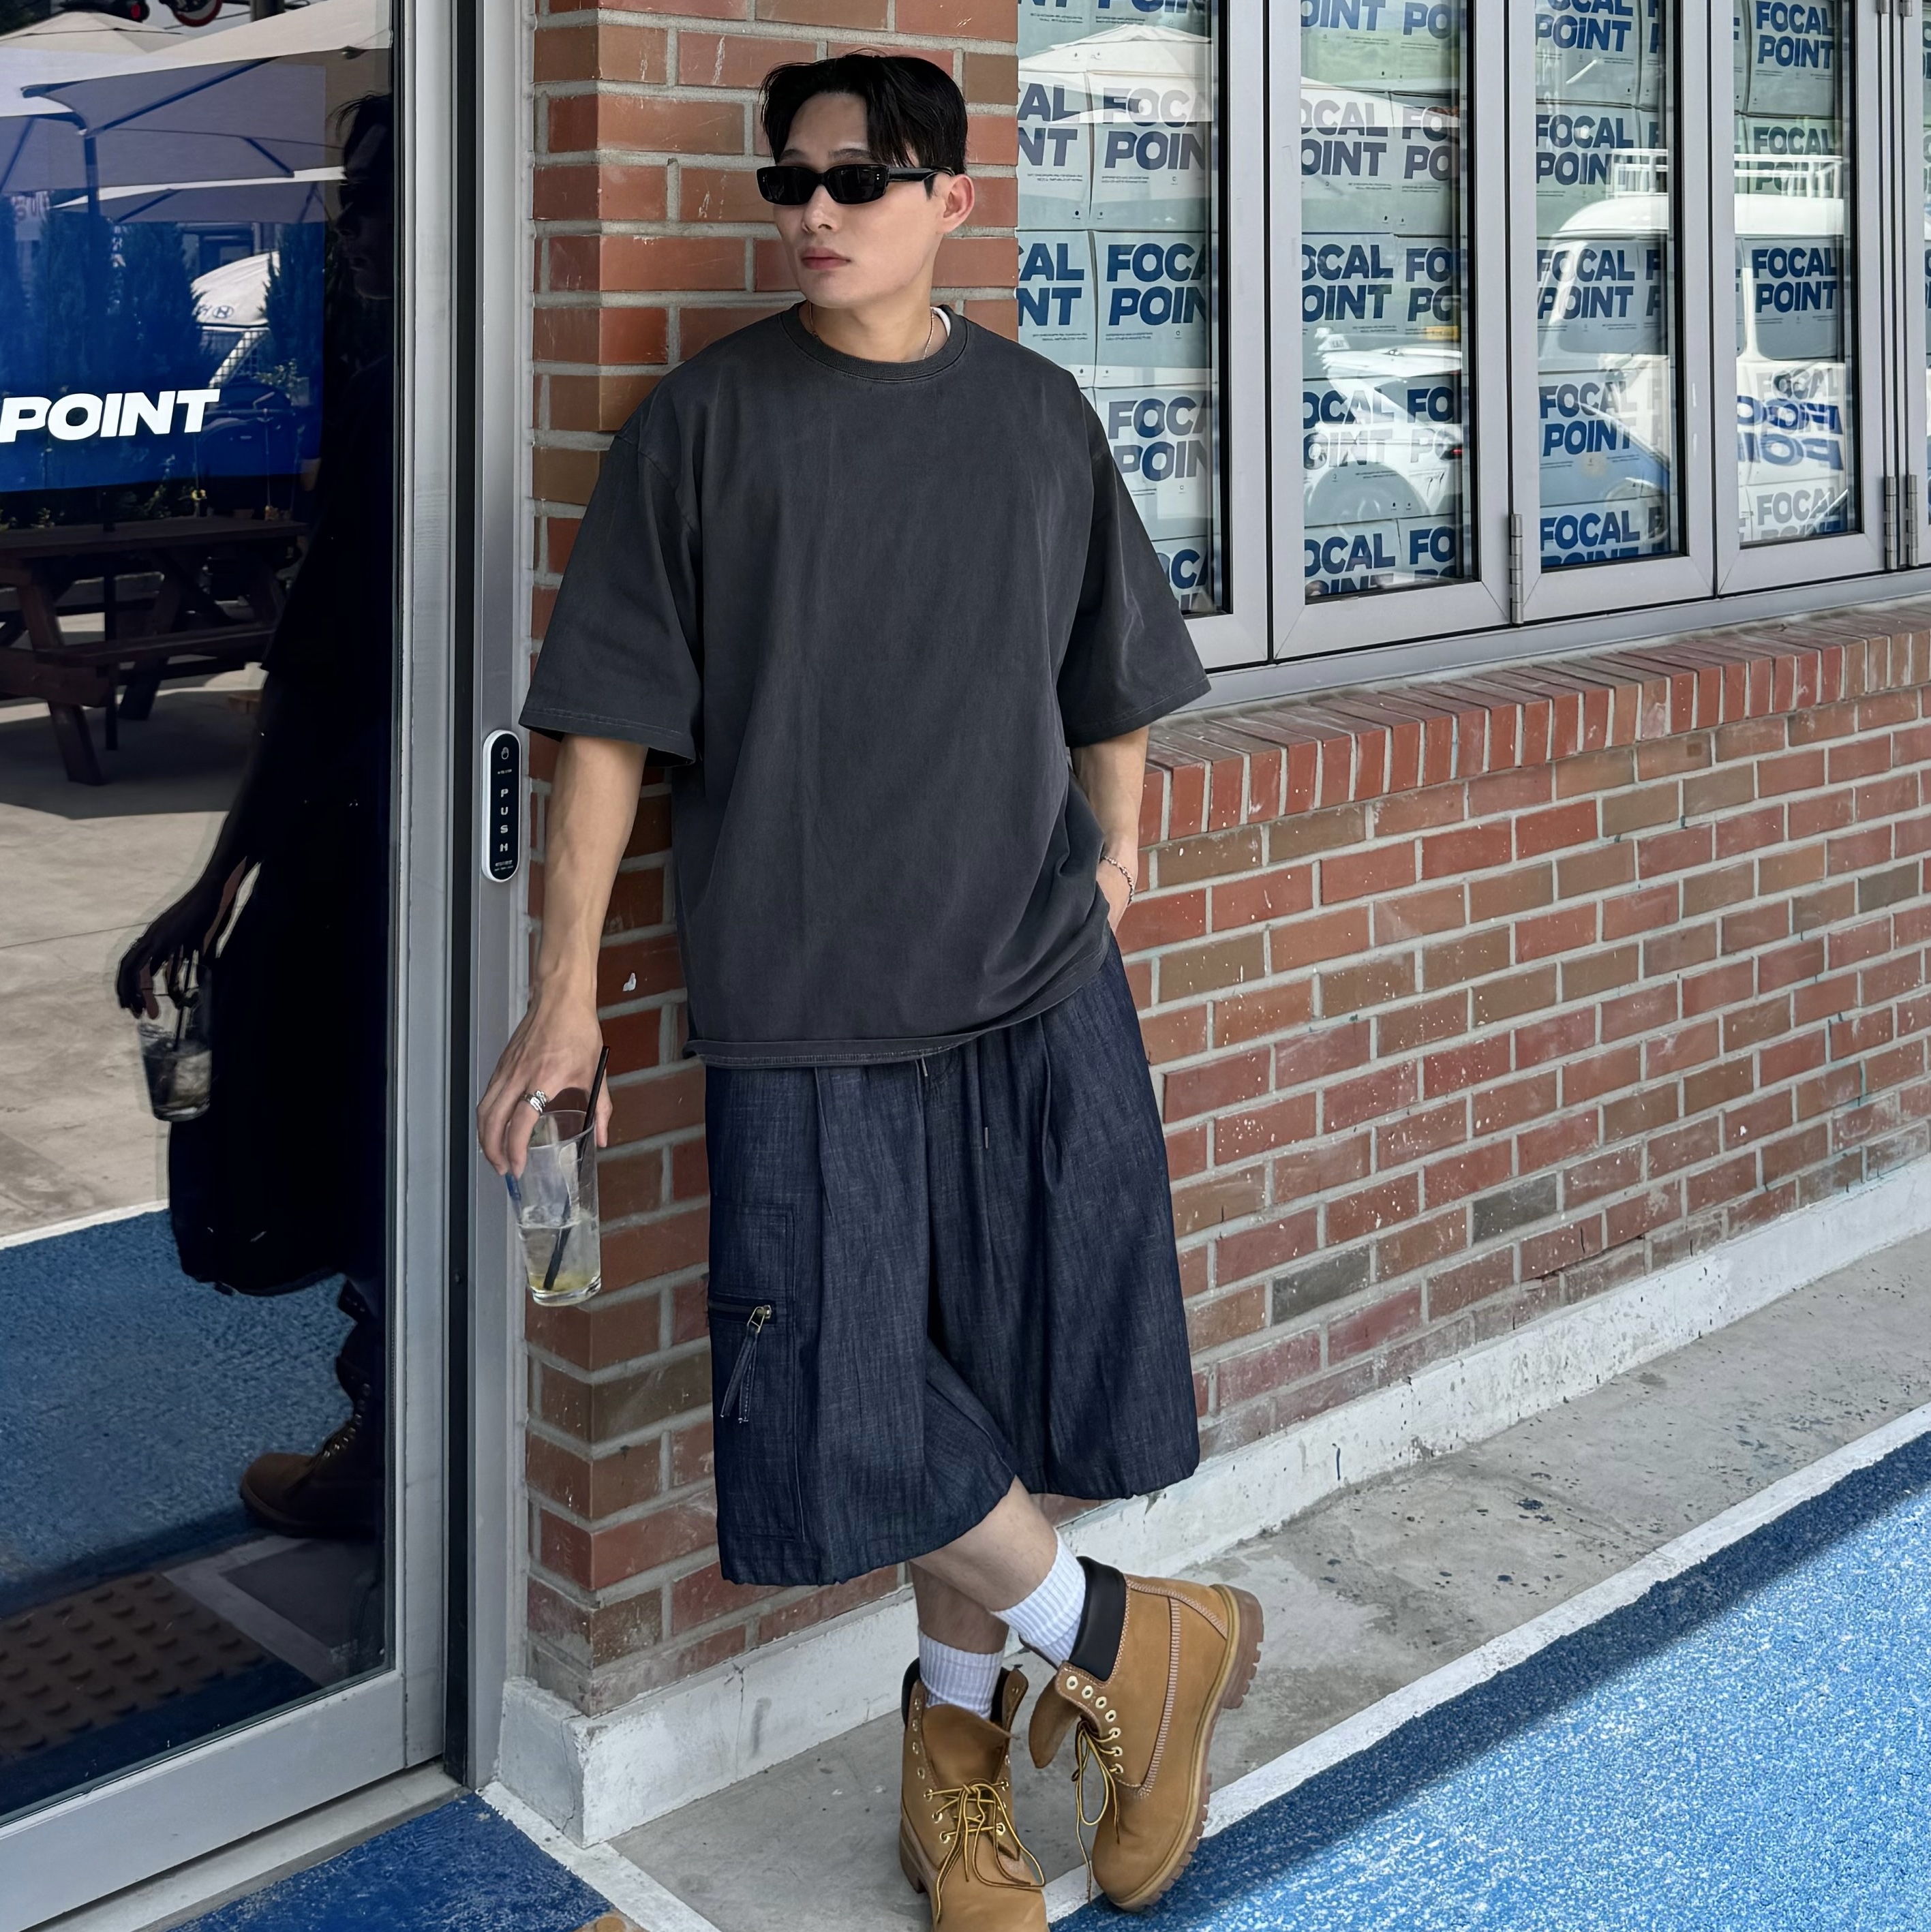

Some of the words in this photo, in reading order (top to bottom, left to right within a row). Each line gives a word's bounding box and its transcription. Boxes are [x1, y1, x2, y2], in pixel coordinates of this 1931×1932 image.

[1536, 14, 1631, 52] POINT
[1756, 1, 1834, 36] FOCAL
[1757, 35, 1834, 69] POINT
[1536, 114, 1634, 149] FOCAL
[1753, 125, 1835, 155] FOCAL
[1018, 243, 1084, 281] AL
[1537, 249, 1635, 282] FOCAL
[1752, 247, 1837, 279] FOCAL
[1538, 286, 1633, 320] POINT
[1755, 281, 1837, 313] POINT
[0, 388, 221, 443] POINT
[1540, 510, 1640, 551] FOCAL
